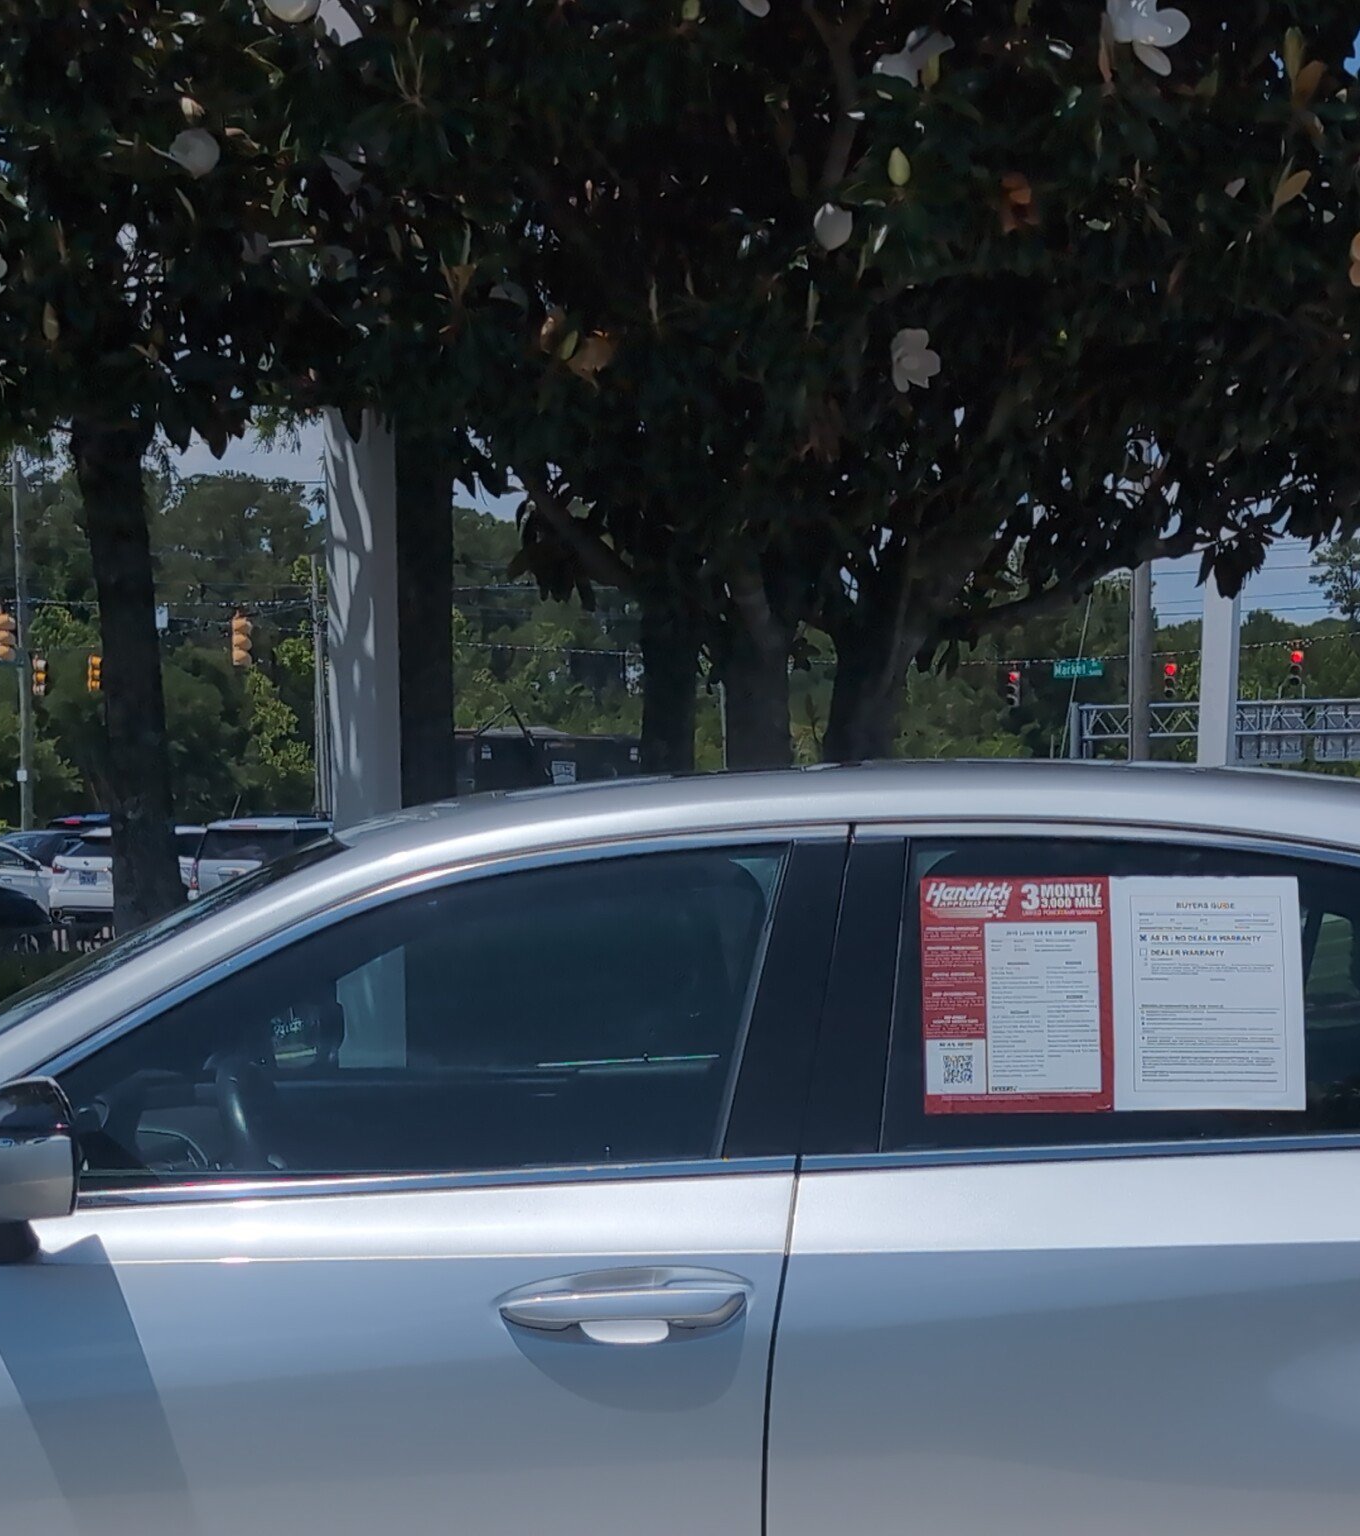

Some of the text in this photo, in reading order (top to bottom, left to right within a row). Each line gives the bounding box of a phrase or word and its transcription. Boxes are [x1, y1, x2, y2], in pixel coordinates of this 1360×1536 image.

[1055, 663, 1086, 675] Market
[1021, 883, 1040, 910] 3
[1040, 883, 1102, 898] MONTH/
[1040, 897, 1102, 909] 3,000 MILE
[1182, 949, 1224, 957] WARRANTY
